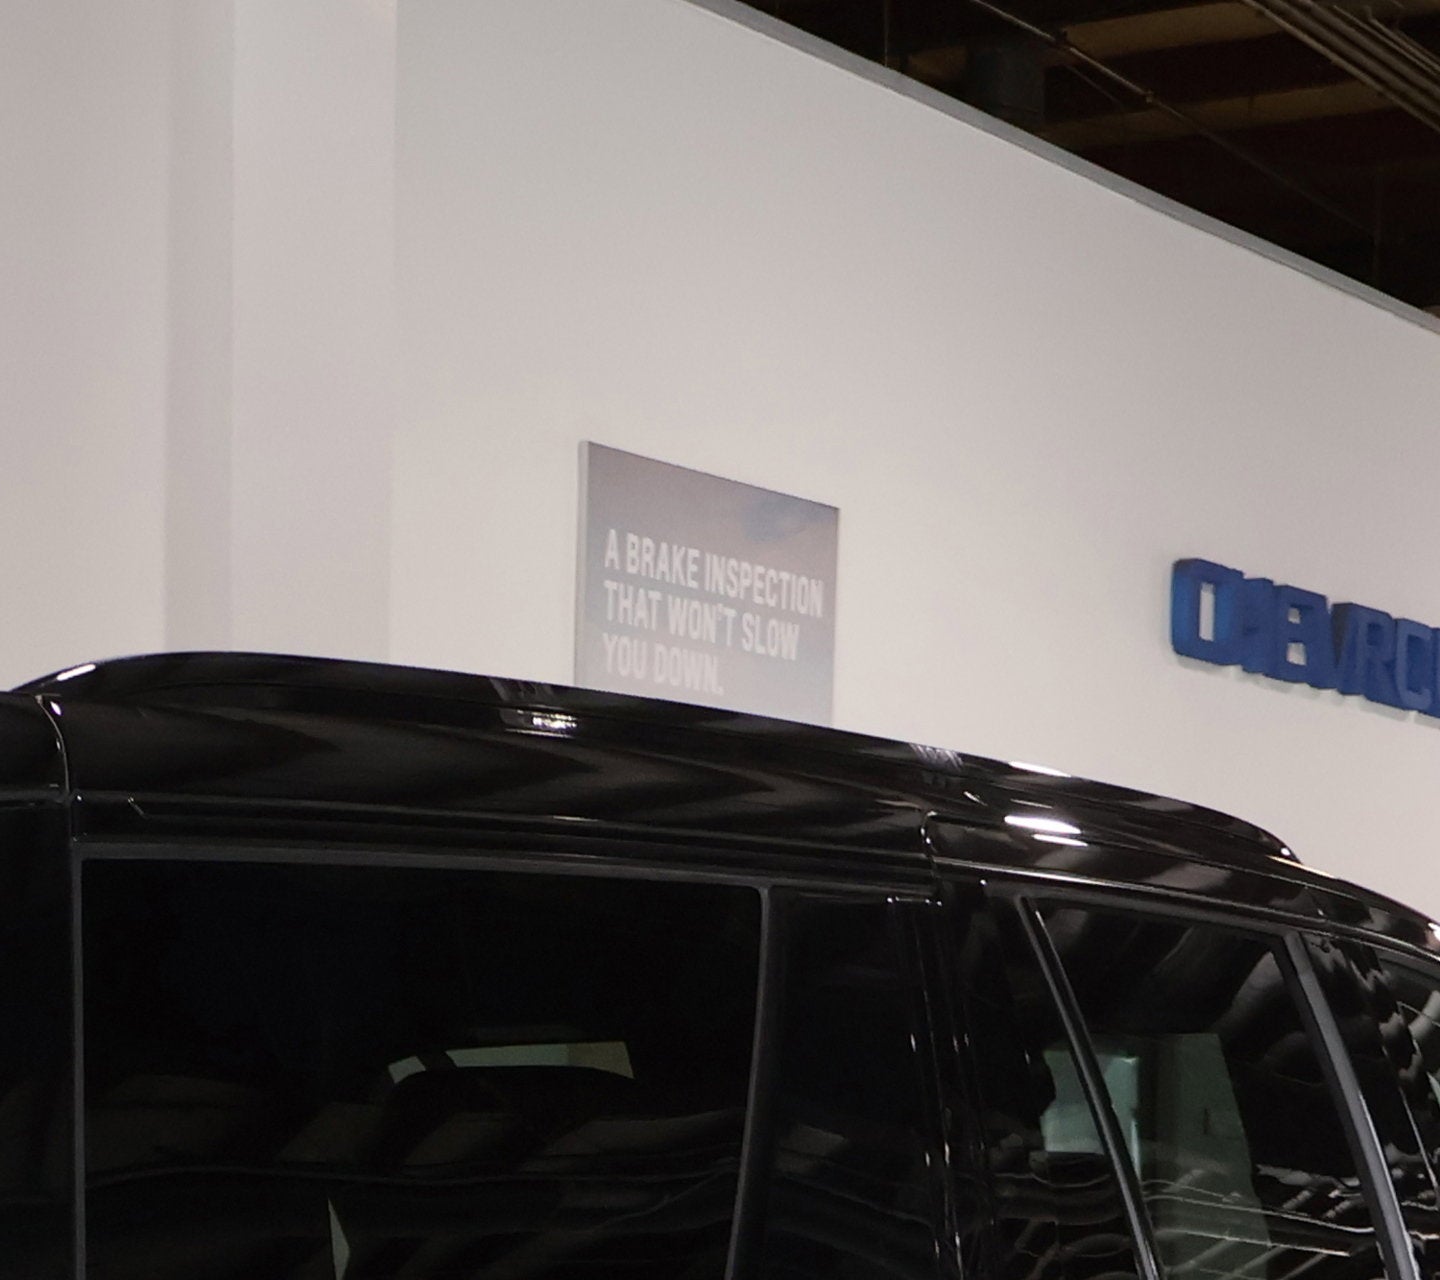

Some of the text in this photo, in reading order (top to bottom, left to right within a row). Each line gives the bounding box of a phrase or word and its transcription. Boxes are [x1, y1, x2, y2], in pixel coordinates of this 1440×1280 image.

[604, 529, 825, 619] A BRAKE INSPECTION
[603, 579, 800, 661] THAT WON'T SLOW
[602, 632, 724, 697] YOU DOWN.
